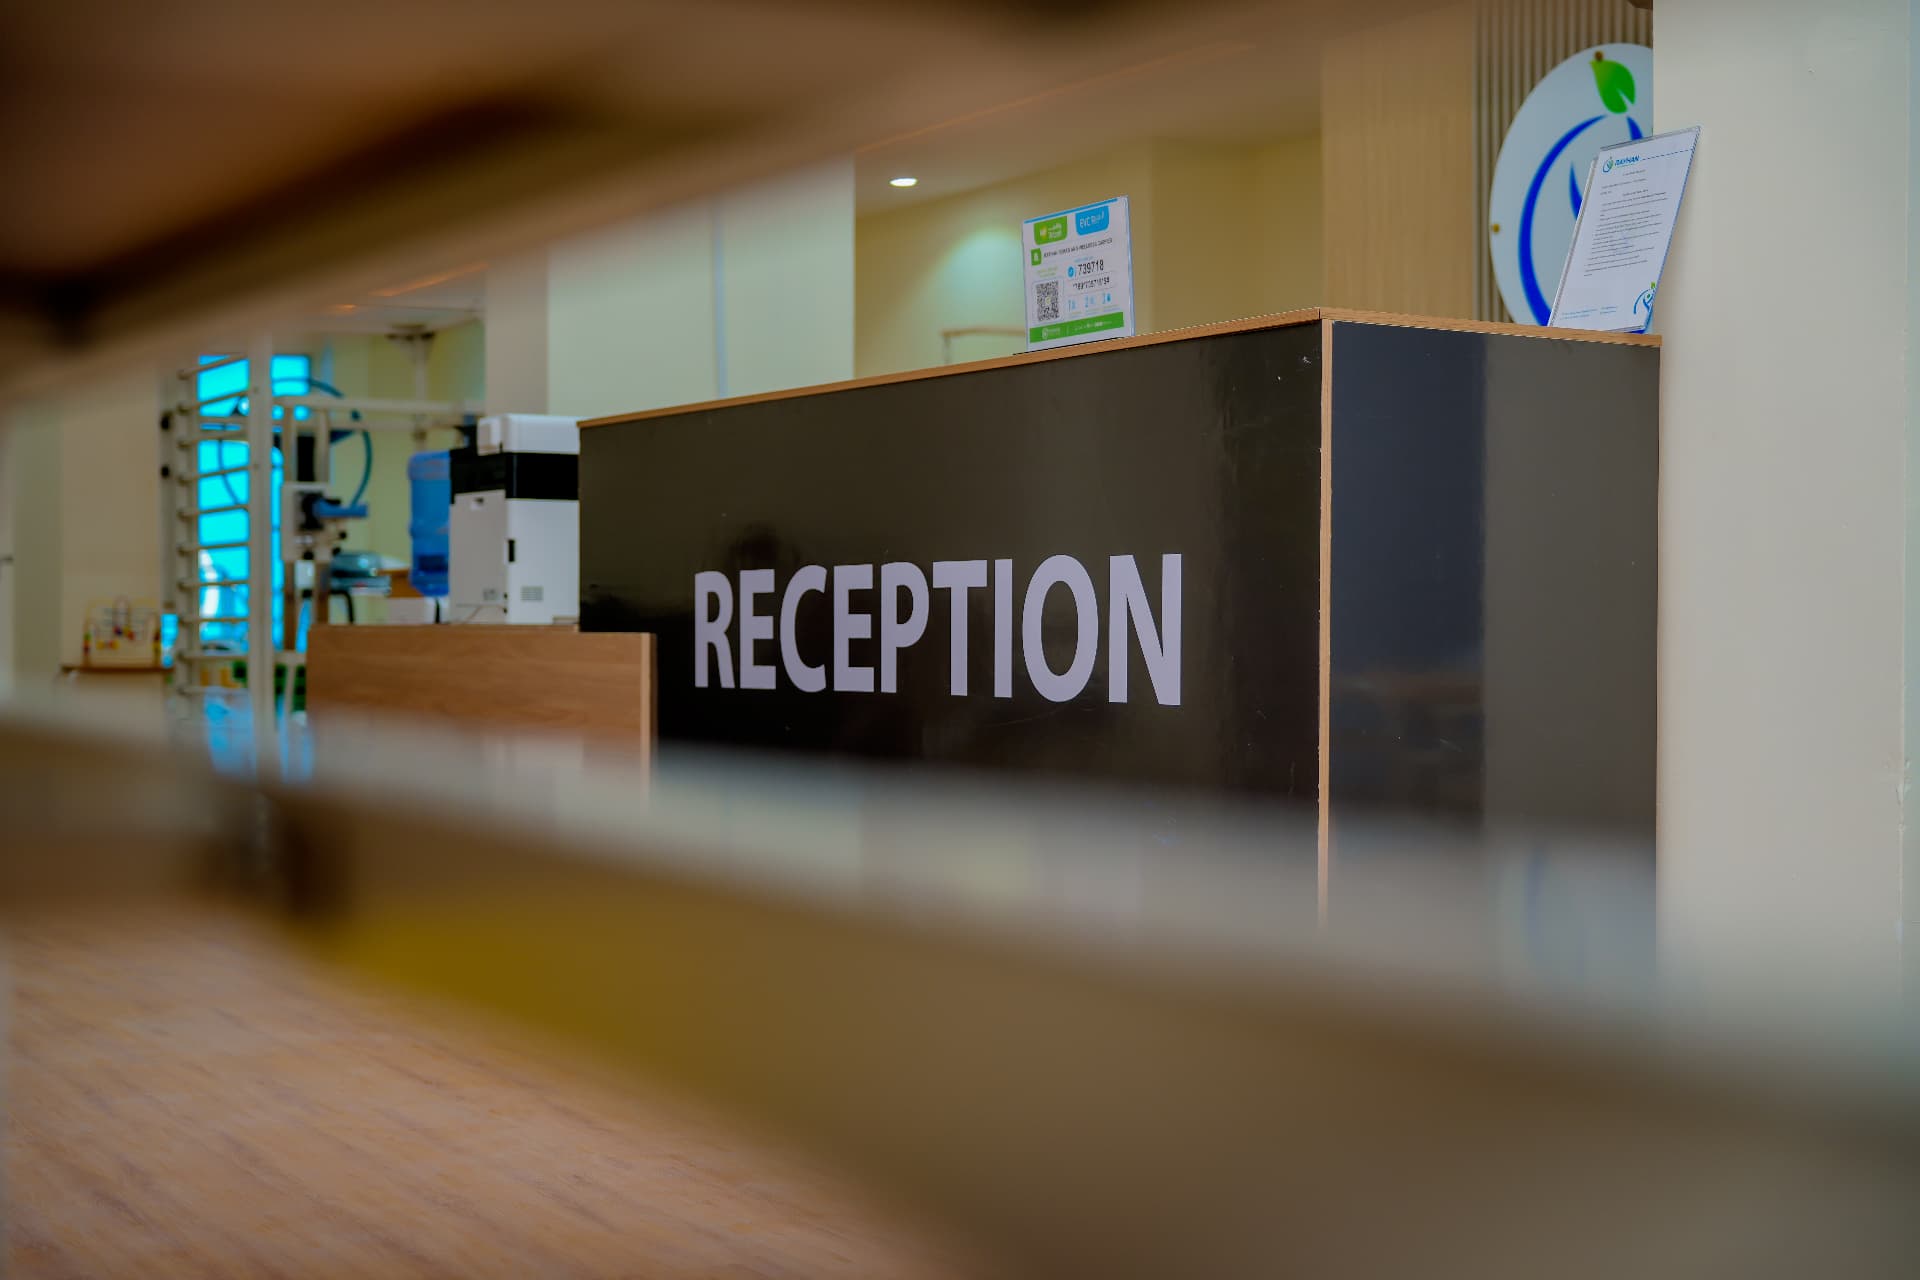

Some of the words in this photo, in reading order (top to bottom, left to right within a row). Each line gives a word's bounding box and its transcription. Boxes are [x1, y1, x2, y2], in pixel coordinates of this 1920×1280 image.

[1615, 154, 1640, 166] RAYHAN
[1078, 259, 1104, 276] 739718
[694, 553, 1182, 706] RECEPTION
